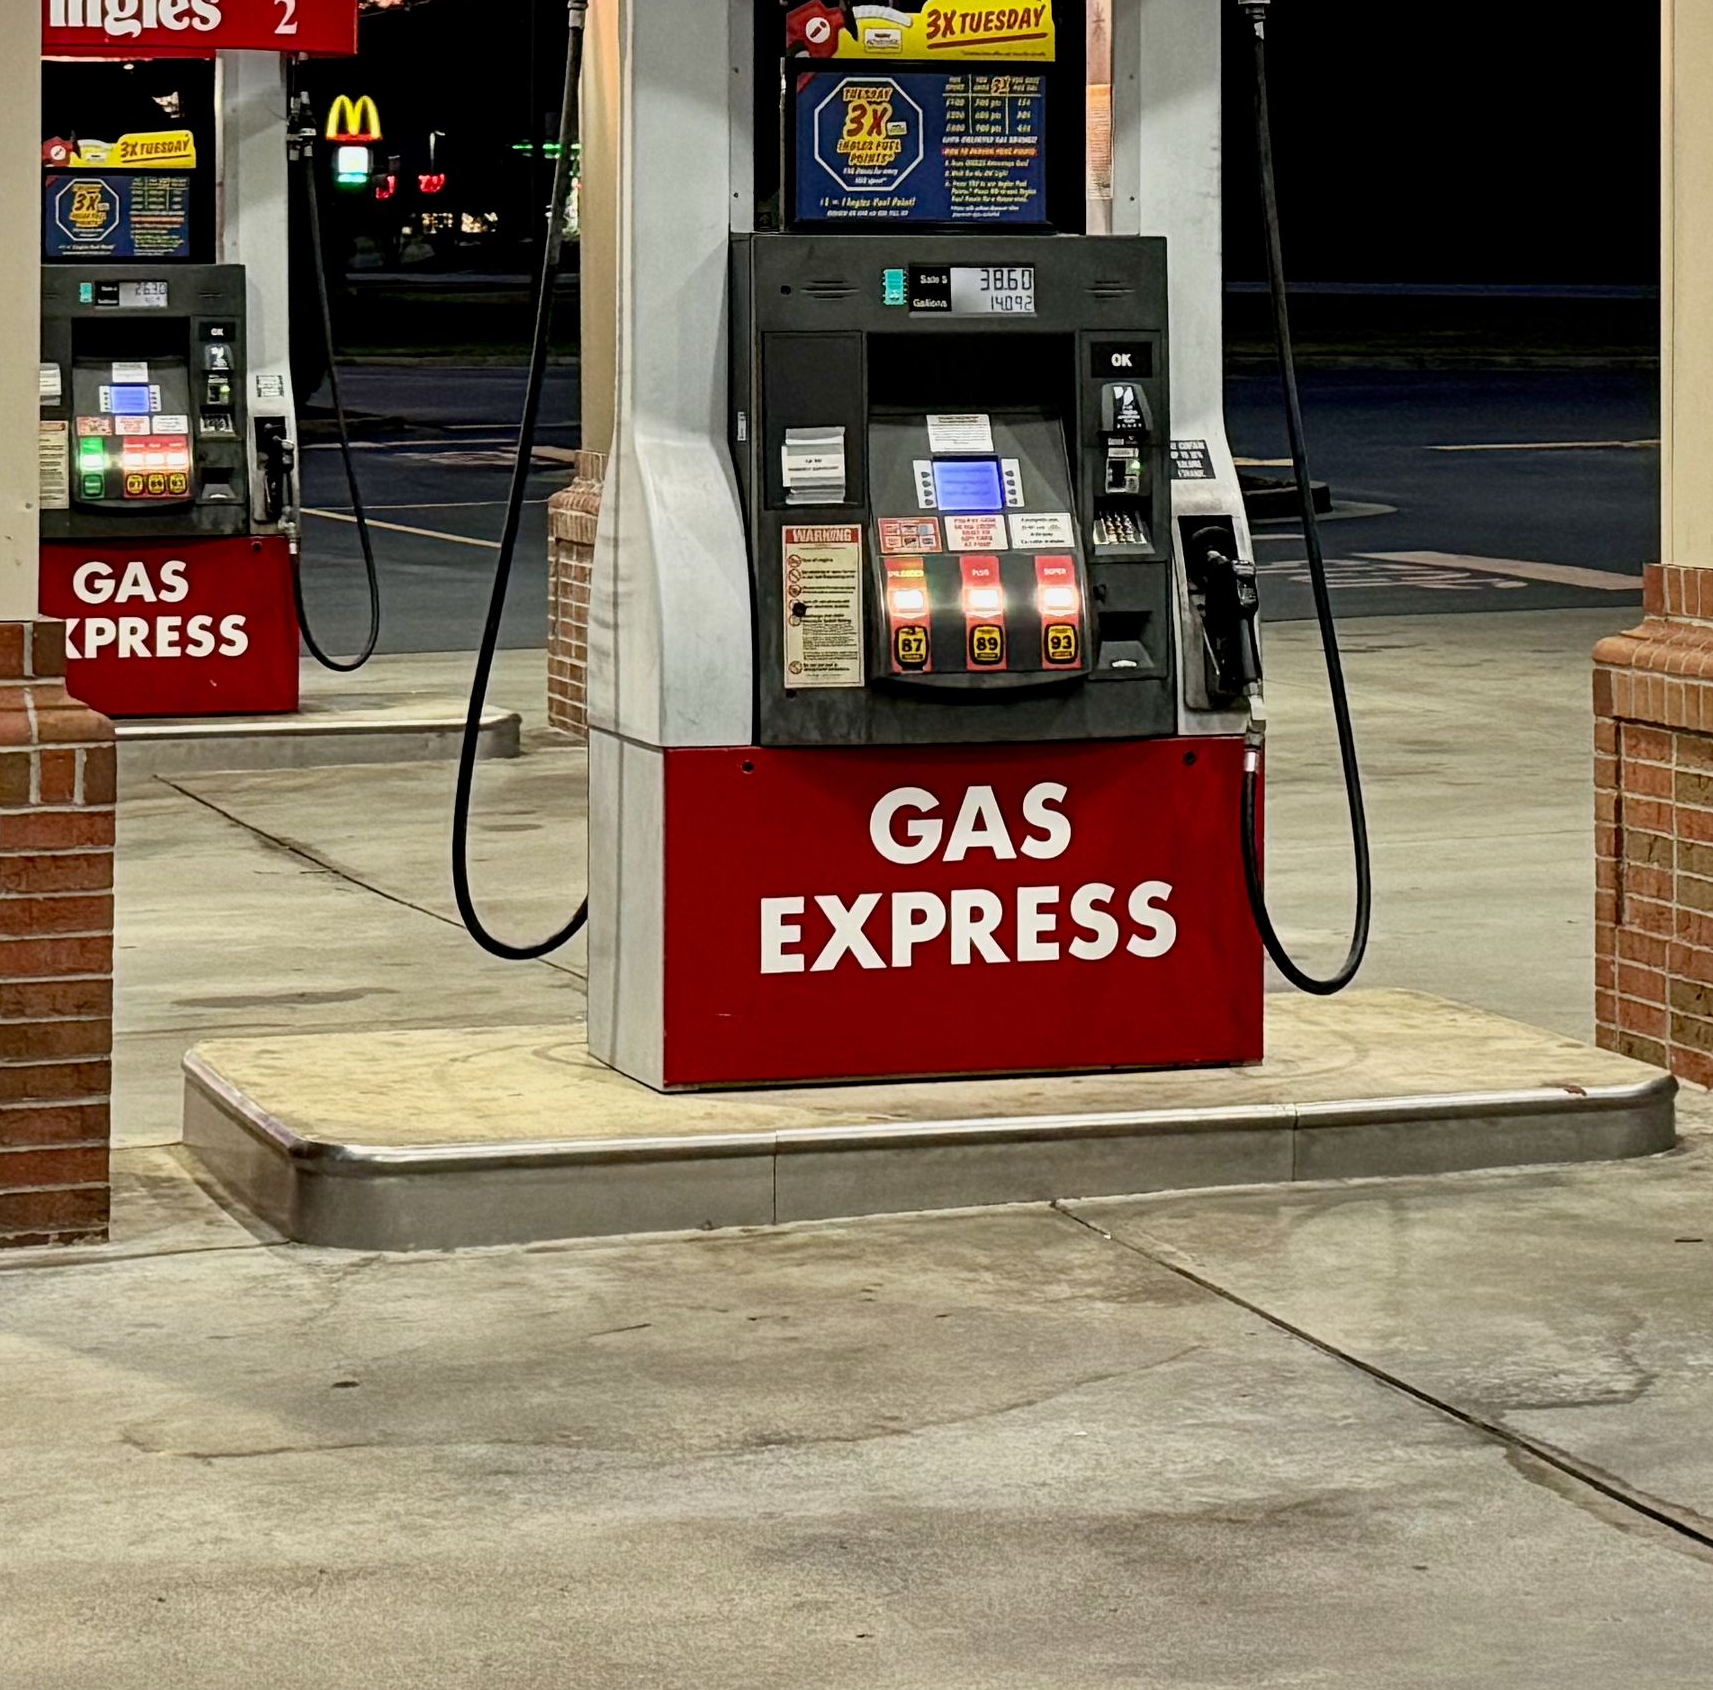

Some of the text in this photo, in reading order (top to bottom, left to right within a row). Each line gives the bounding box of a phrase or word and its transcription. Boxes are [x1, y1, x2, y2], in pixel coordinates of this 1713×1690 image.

[926, 4, 1047, 40] 3X TUESDAY
[843, 88, 892, 101] TUESDAY
[846, 103, 889, 138] 3X
[120, 139, 191, 158] 3X TUESDAY
[73, 192, 99, 211] 3X
[1111, 353, 1133, 367] OK
[792, 528, 852, 544] WARNING
[73, 559, 189, 604] GAS
[901, 638, 923, 653] 87
[976, 636, 999, 651] 89
[1050, 635, 1072, 650] 93
[869, 781, 1072, 865] GAS
[760, 880, 1177, 973] EXPRESS
